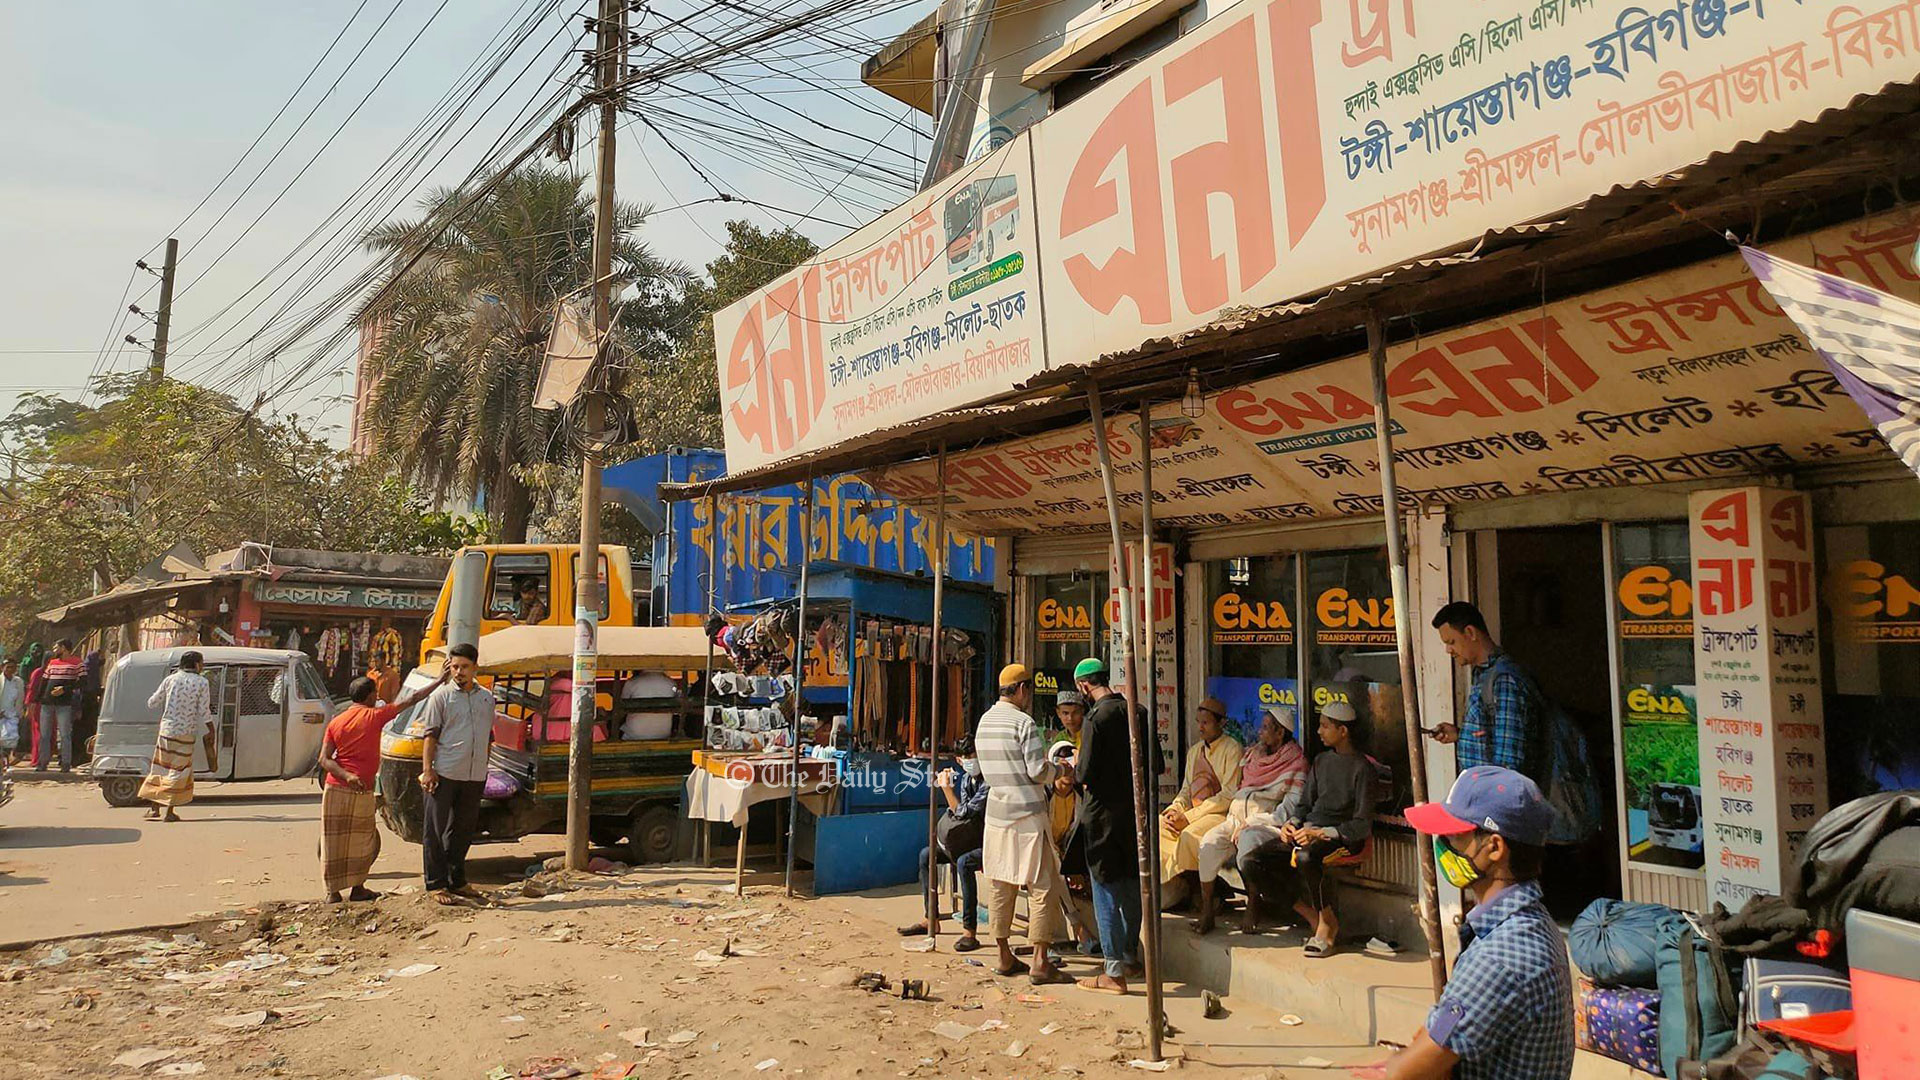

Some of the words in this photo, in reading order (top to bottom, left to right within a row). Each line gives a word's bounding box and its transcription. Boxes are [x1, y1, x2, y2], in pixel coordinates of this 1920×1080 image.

[1060, 0, 1326, 324] এনা
[825, 195, 936, 322] ট্রান্সপোর্ট
[727, 264, 826, 454] এনা
[1387, 315, 1600, 418] এনা
[1261, 433, 1333, 453] TRANSPORT
[1296, 453, 1365, 479] টঙ্গী
[1575, 396, 1713, 441] সিলেট
[1215, 634, 1255, 642] TRANSPORT
[1318, 633, 1366, 642] TRANSPORT
[1623, 624, 1693, 634] TRANSPOR
[1701, 624, 1759, 653] ট্রান্সপোর্ট
[1721, 690, 1743, 712] টঙ্গী
[1715, 742, 1754, 766] হবিগঞ্জ
[1717, 771, 1753, 796] সিলেট
[1720, 797, 1754, 816] ছাতক
[1714, 822, 1763, 846] সুনামগঞ্জ
